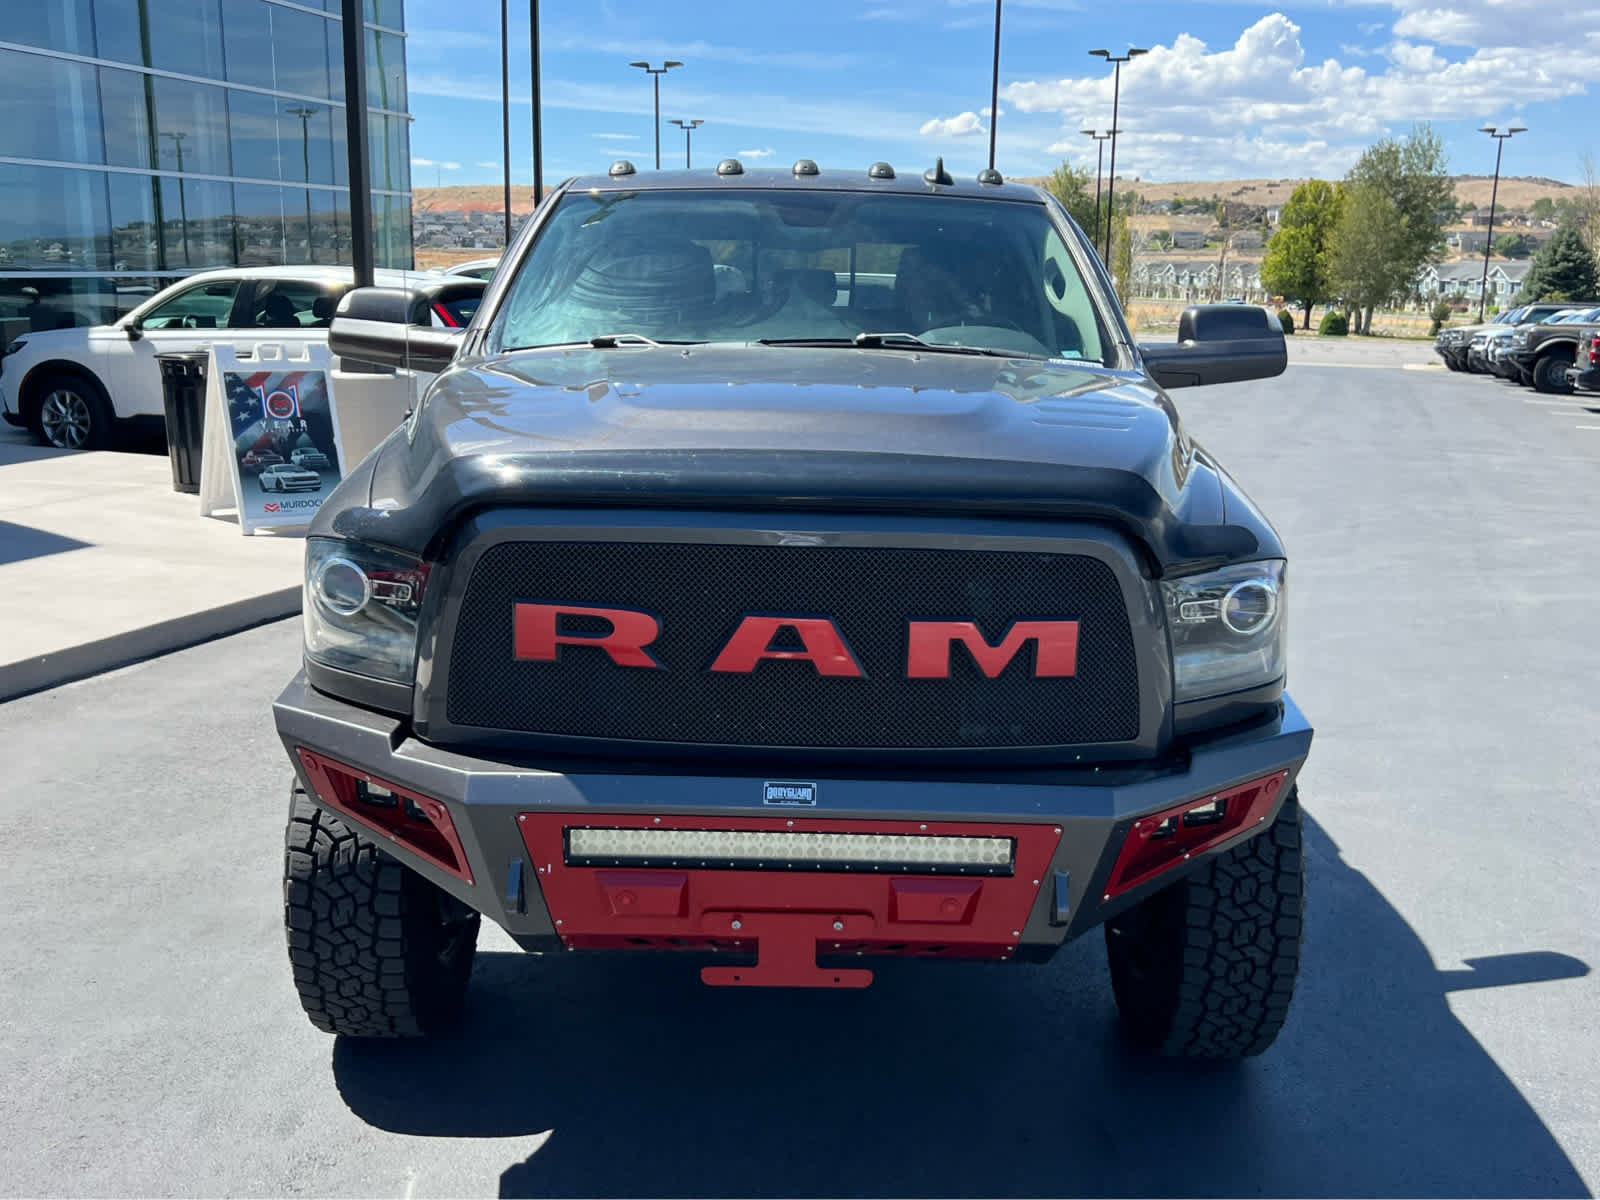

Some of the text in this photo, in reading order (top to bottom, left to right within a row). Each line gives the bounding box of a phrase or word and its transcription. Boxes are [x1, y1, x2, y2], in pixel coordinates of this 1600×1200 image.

[256, 384, 304, 418] 101
[260, 420, 308, 429] YEAR
[512, 600, 1080, 679] RAM
[767, 786, 812, 801] BODYGUARD
